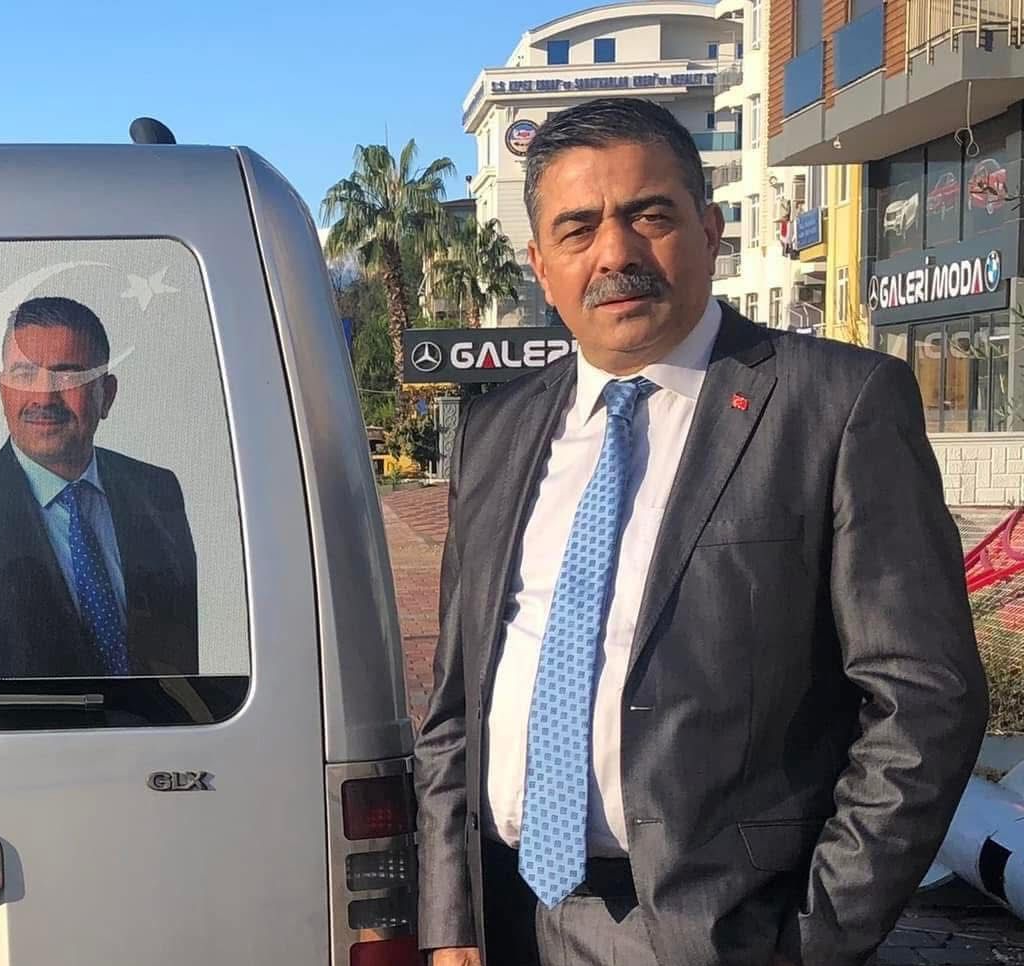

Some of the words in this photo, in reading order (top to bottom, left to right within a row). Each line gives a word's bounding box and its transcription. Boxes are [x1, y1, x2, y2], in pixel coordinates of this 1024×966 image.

[880, 256, 929, 308] GALERİ
[931, 257, 984, 301] MODA
[146, 771, 215, 791] GLX
